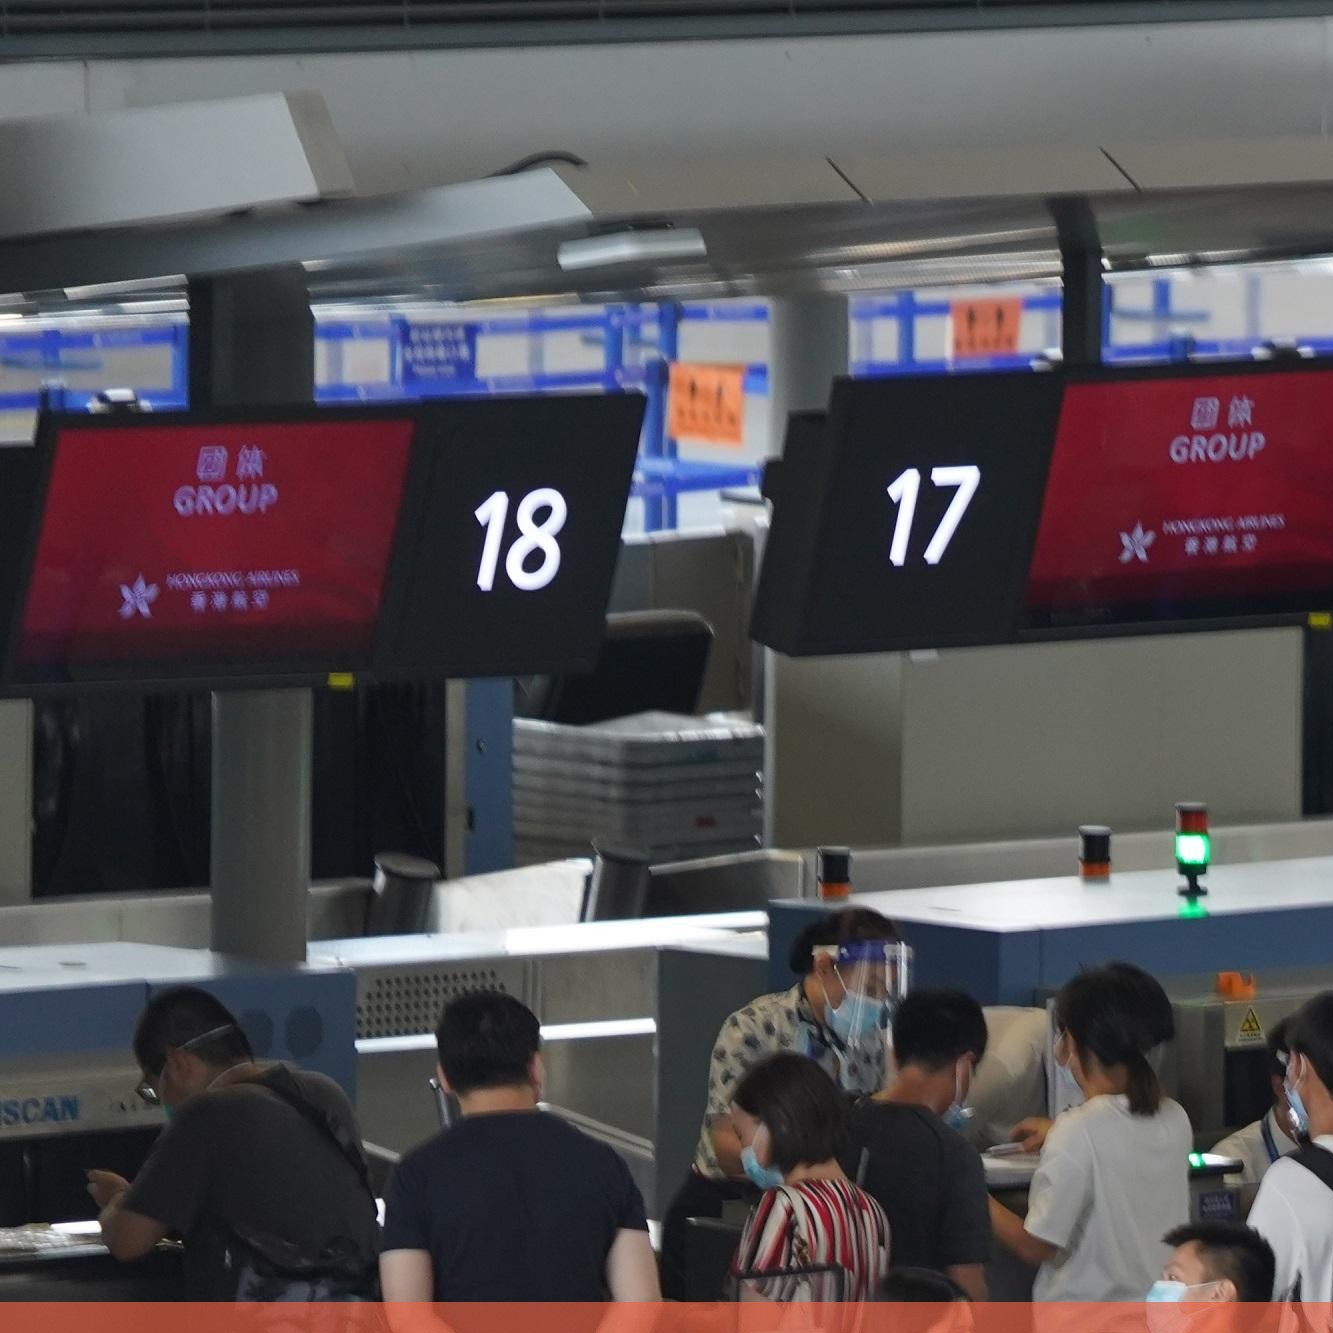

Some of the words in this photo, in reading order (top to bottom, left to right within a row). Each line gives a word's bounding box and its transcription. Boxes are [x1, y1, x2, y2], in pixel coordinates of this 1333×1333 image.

[1169, 431, 1265, 464] GROUP
[173, 484, 278, 517] GROUP
[886, 465, 981, 567] 17
[474, 487, 567, 591] 18
[0, 1095, 80, 1126] SCAN
